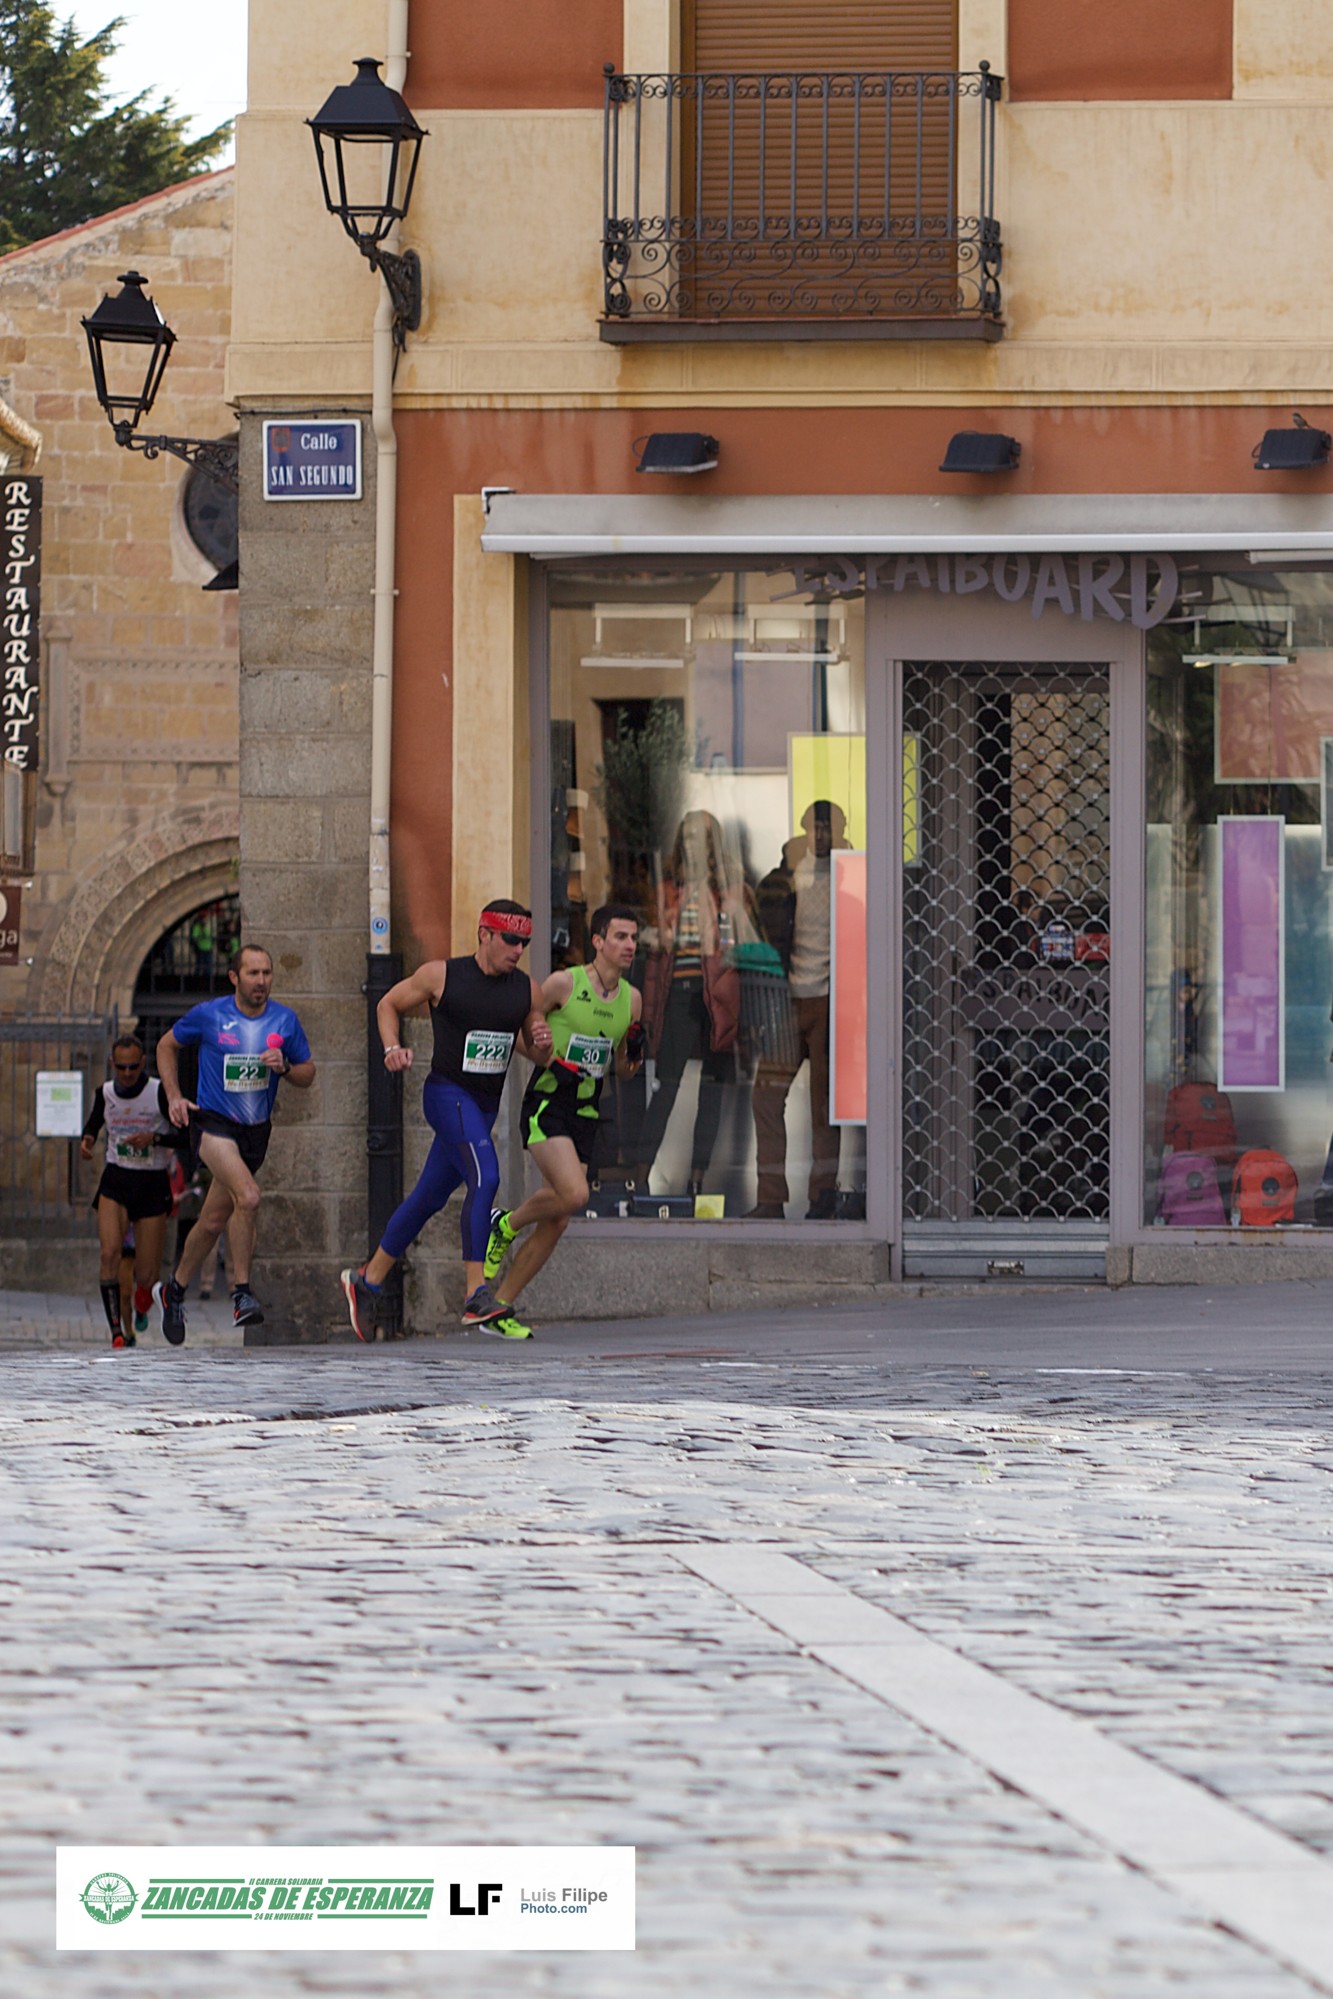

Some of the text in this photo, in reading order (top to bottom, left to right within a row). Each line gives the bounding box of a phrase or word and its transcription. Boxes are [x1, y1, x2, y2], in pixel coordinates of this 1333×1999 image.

[300, 432, 338, 450] Calle
[271, 465, 354, 486] SAN SEGUNDO
[3, 481, 38, 769] RESTAURANTE
[475, 1044, 505, 1060] 222
[581, 1048, 600, 1064] 30
[238, 1065, 259, 1080] 22
